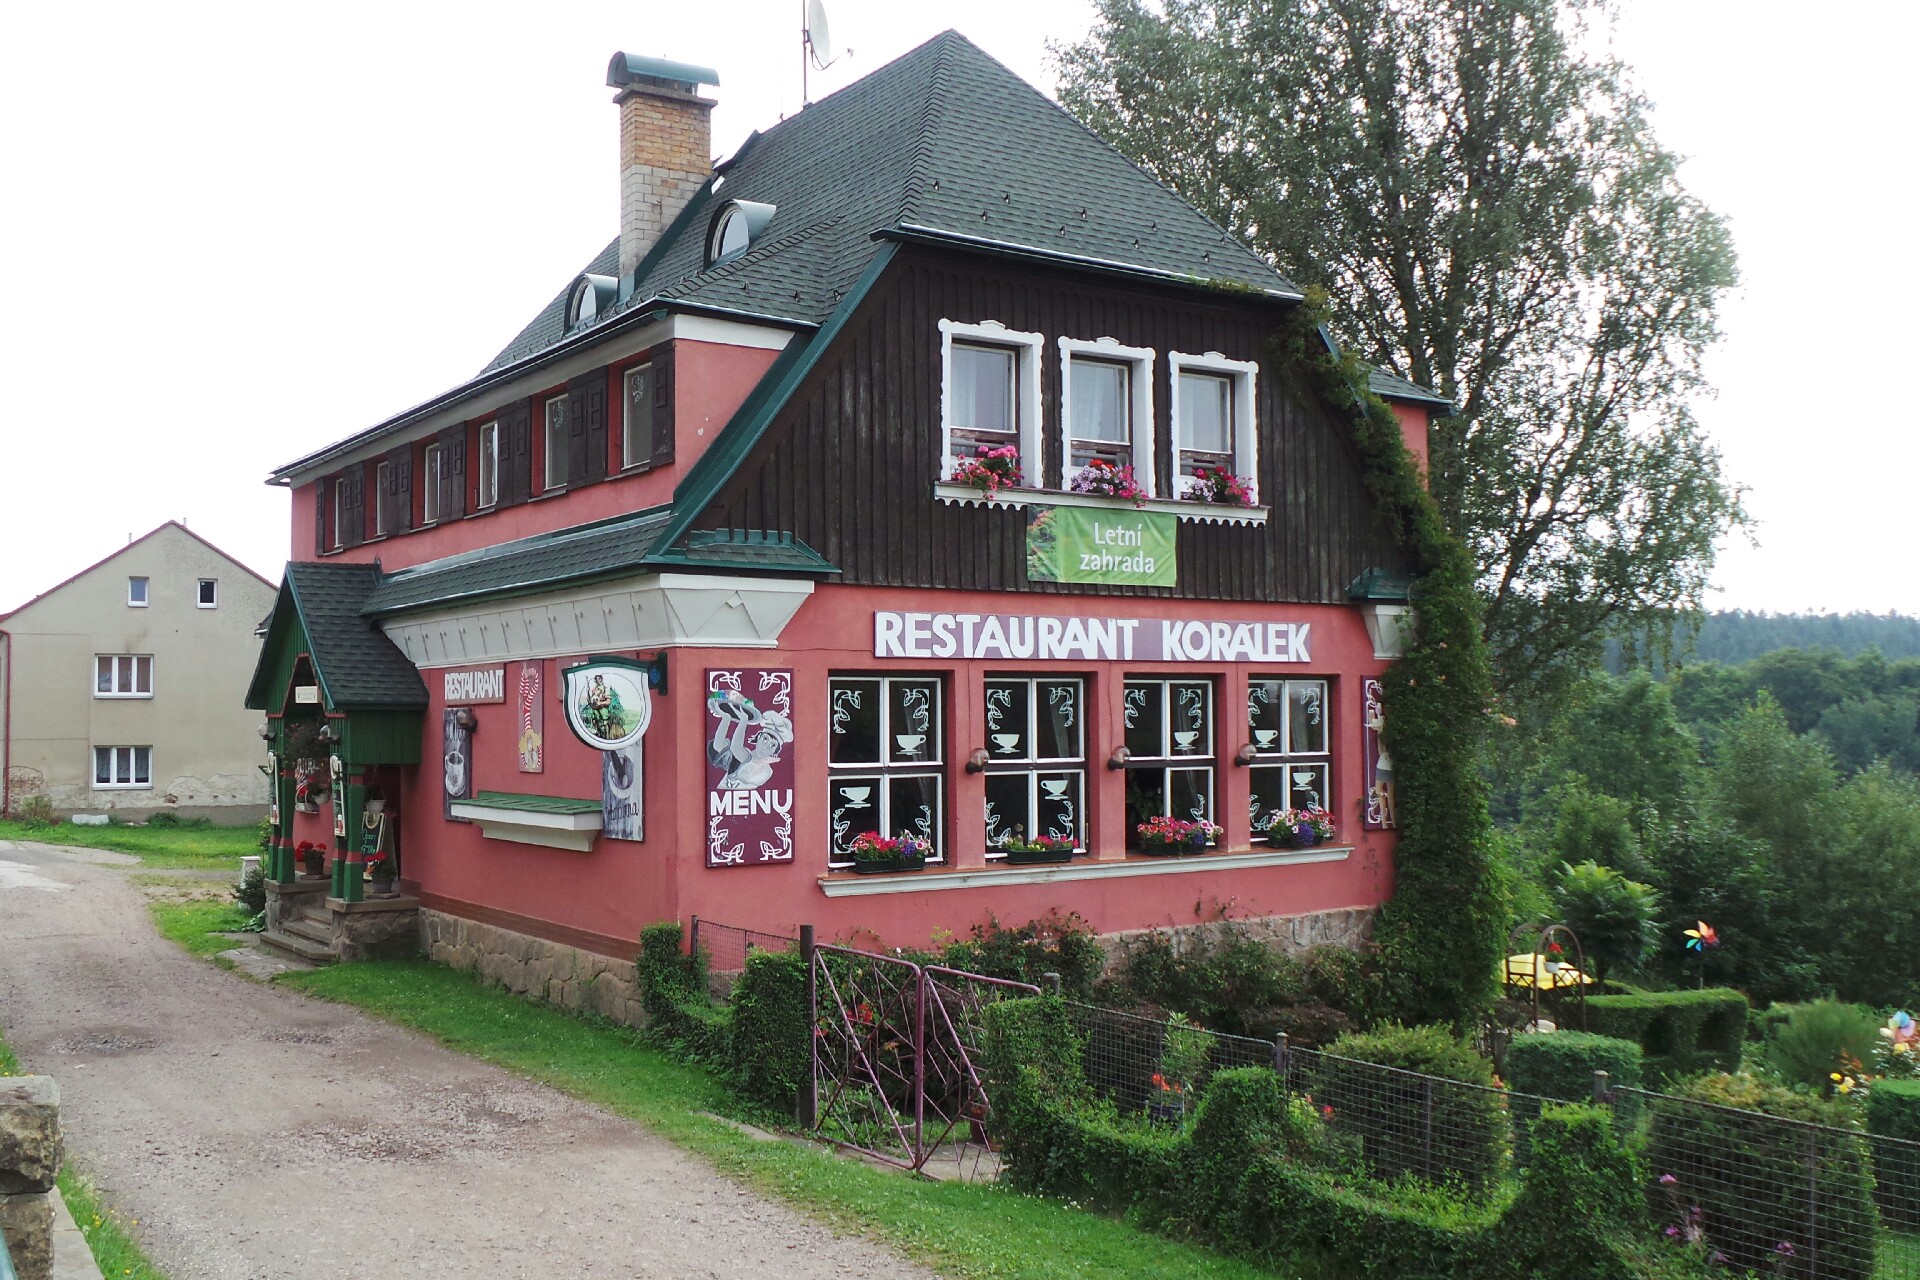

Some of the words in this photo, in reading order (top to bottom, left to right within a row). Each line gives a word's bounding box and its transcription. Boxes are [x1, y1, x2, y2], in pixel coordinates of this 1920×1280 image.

[1094, 522, 1142, 547] Letní
[1080, 549, 1155, 573] zahrada
[876, 612, 1140, 660] RESTAURANT
[1162, 620, 1311, 663] KORÁLEK
[445, 669, 504, 700] RESTAURANT
[710, 788, 793, 816] MENU
